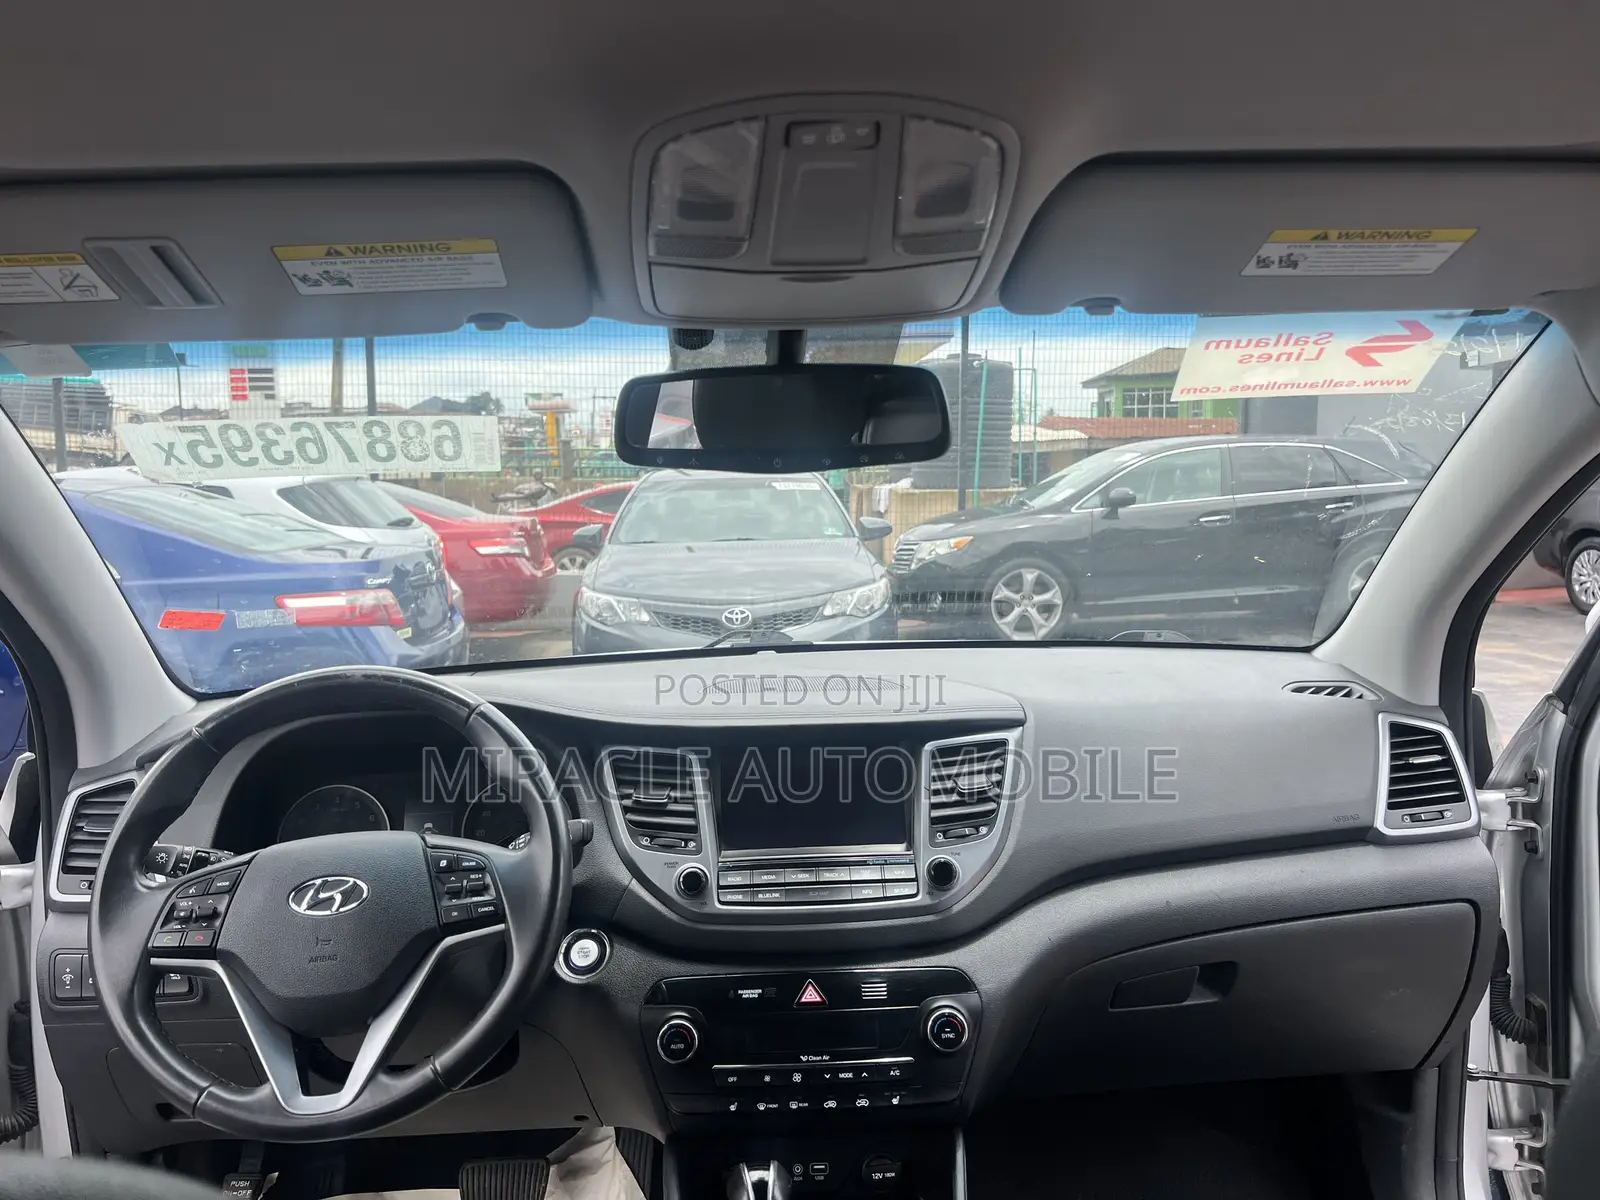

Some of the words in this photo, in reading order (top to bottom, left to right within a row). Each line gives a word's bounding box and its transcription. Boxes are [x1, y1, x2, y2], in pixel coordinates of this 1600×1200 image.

[1336, 230, 1432, 242] WARNING
[346, 241, 453, 257] WARNING
[340, 259, 366, 267] WITH
[369, 257, 425, 266] ADVANCED
[1332, 814, 1361, 823] AIRBAG
[309, 954, 340, 963] AIRBAG
[230, 1180, 251, 1188] PUSH
[222, 1189, 253, 1197] ON-OFF
